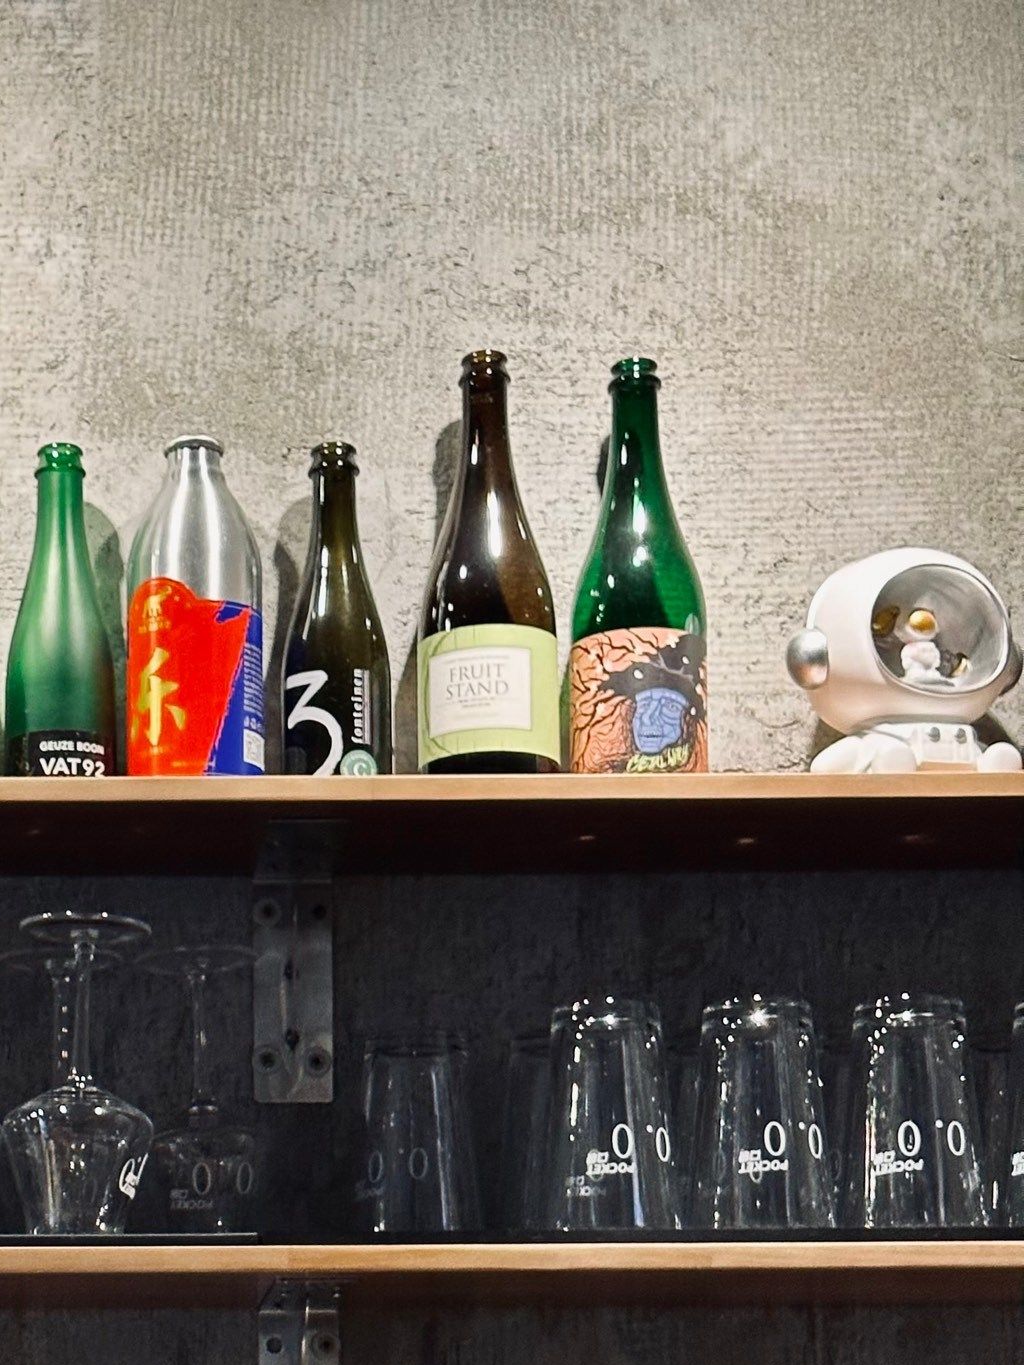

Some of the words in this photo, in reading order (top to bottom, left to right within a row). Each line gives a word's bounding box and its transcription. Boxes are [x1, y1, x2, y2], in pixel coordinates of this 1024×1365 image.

[448, 663, 506, 683] FRUIT
[445, 680, 510, 700] STAND
[286, 669, 343, 776] 3
[39, 740, 75, 752] GEUZE
[76, 741, 105, 755] BOON
[586, 1161, 634, 1176] POCKET
[738, 1159, 789, 1175] POCKET
[875, 1158, 925, 1178] POCKET
